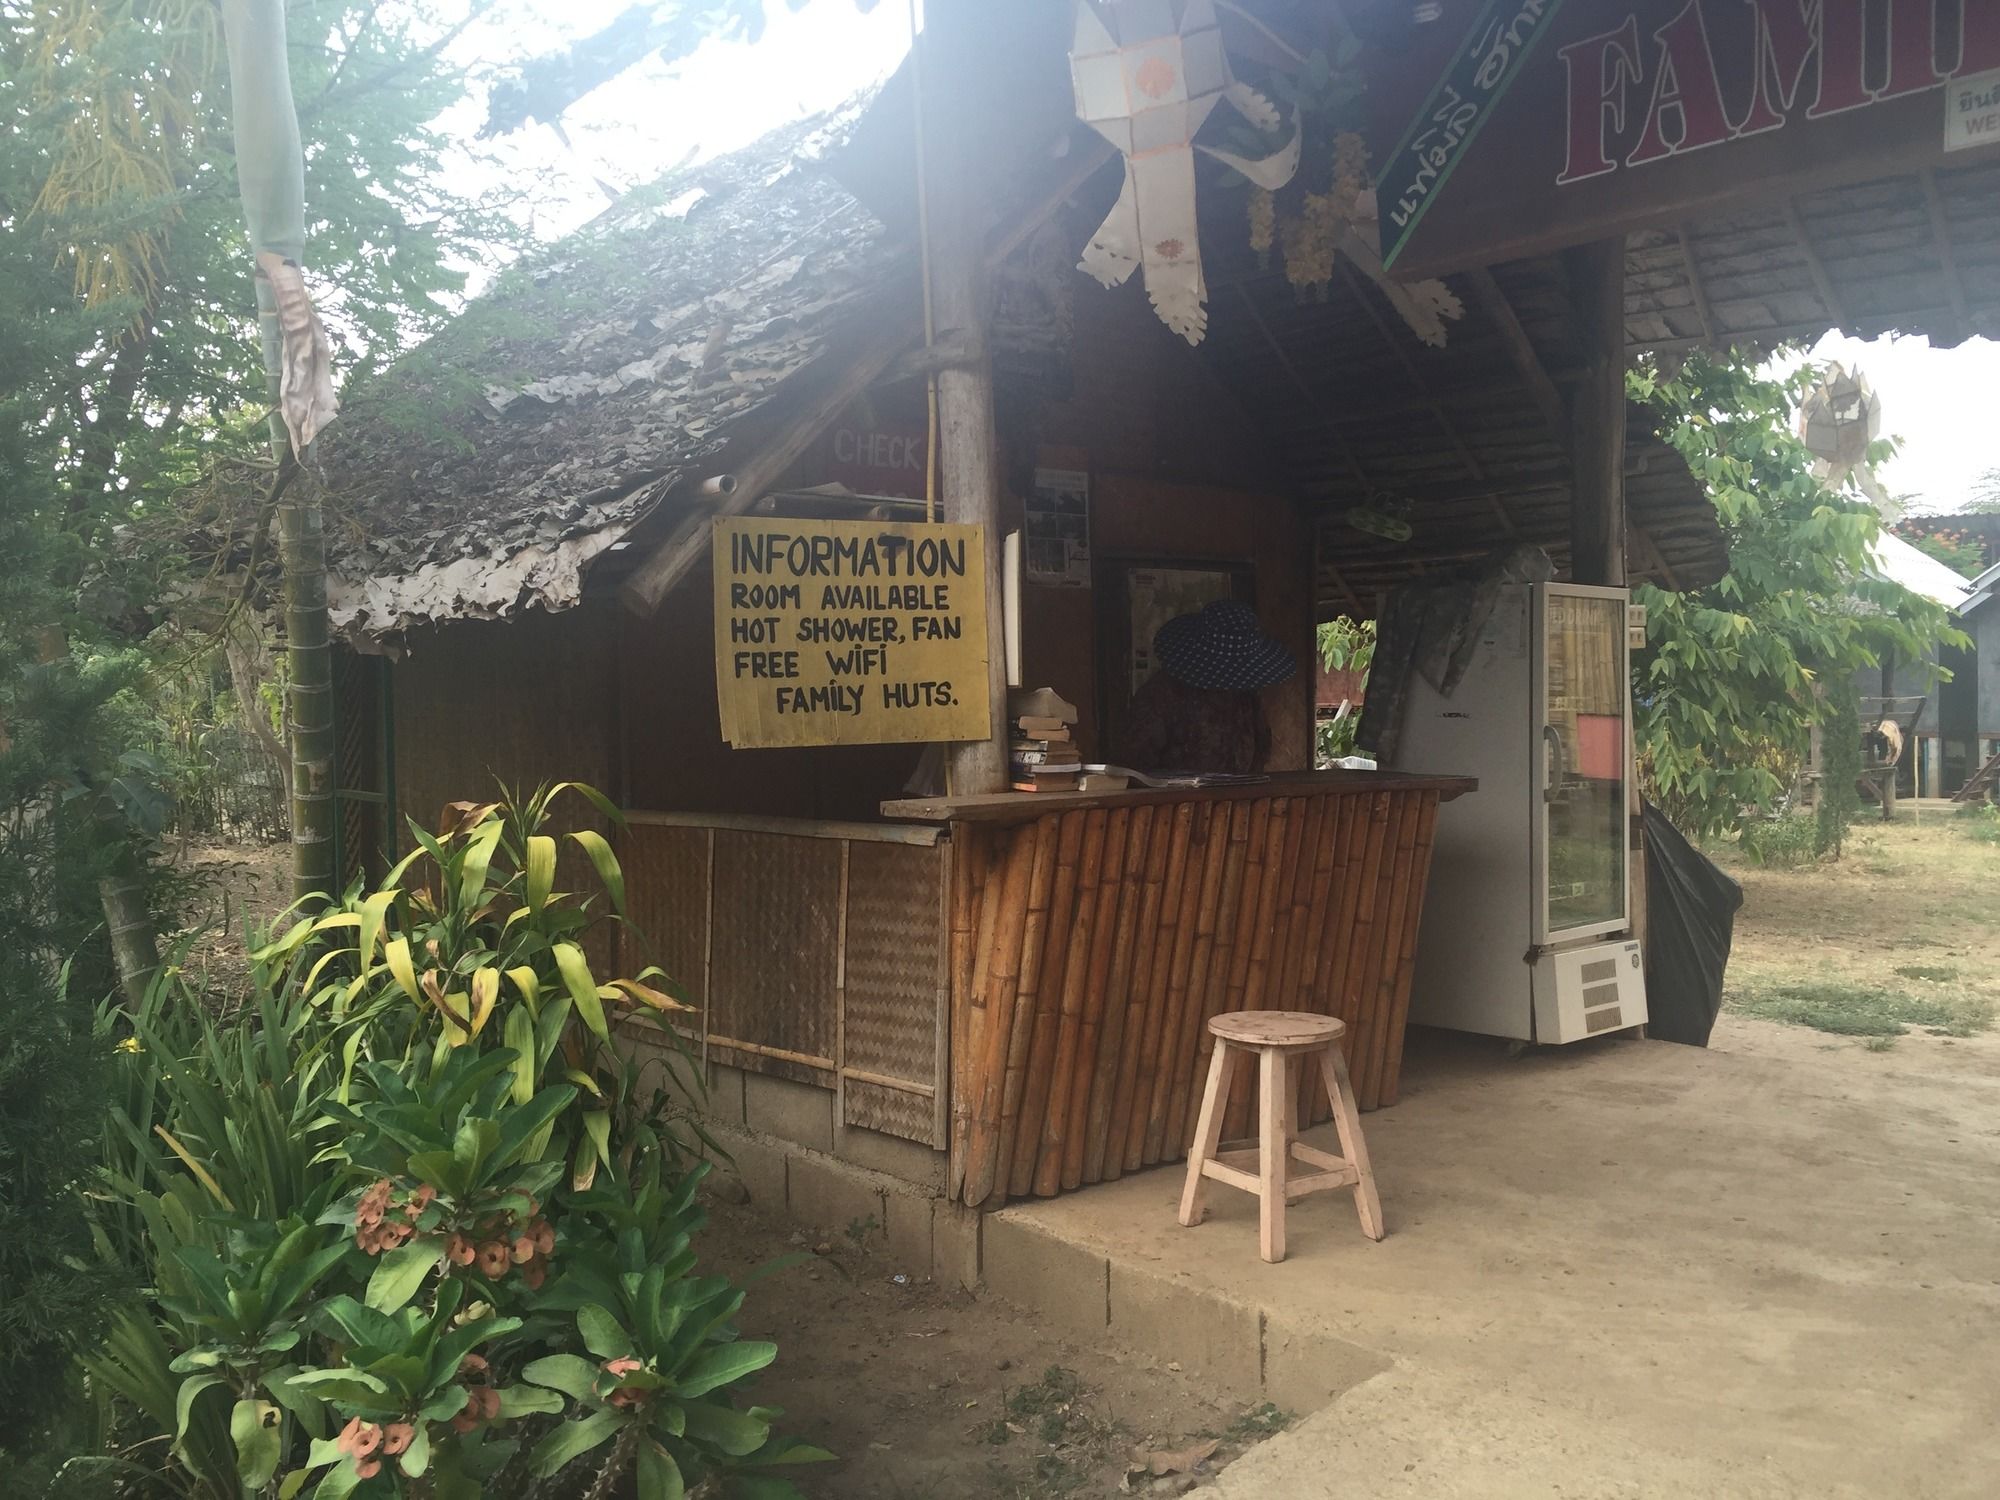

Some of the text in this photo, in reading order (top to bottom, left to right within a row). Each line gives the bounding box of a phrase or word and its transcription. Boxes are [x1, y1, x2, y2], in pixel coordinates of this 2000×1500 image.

[833, 428, 922, 472] CHECK
[731, 532, 966, 578] INFORMATION
[730, 582, 951, 611] ROOM AVAILABLE
[730, 616, 962, 645] HOT SHOWER, FAN
[734, 651, 800, 679] FREE
[882, 681, 959, 709] HUTS.
